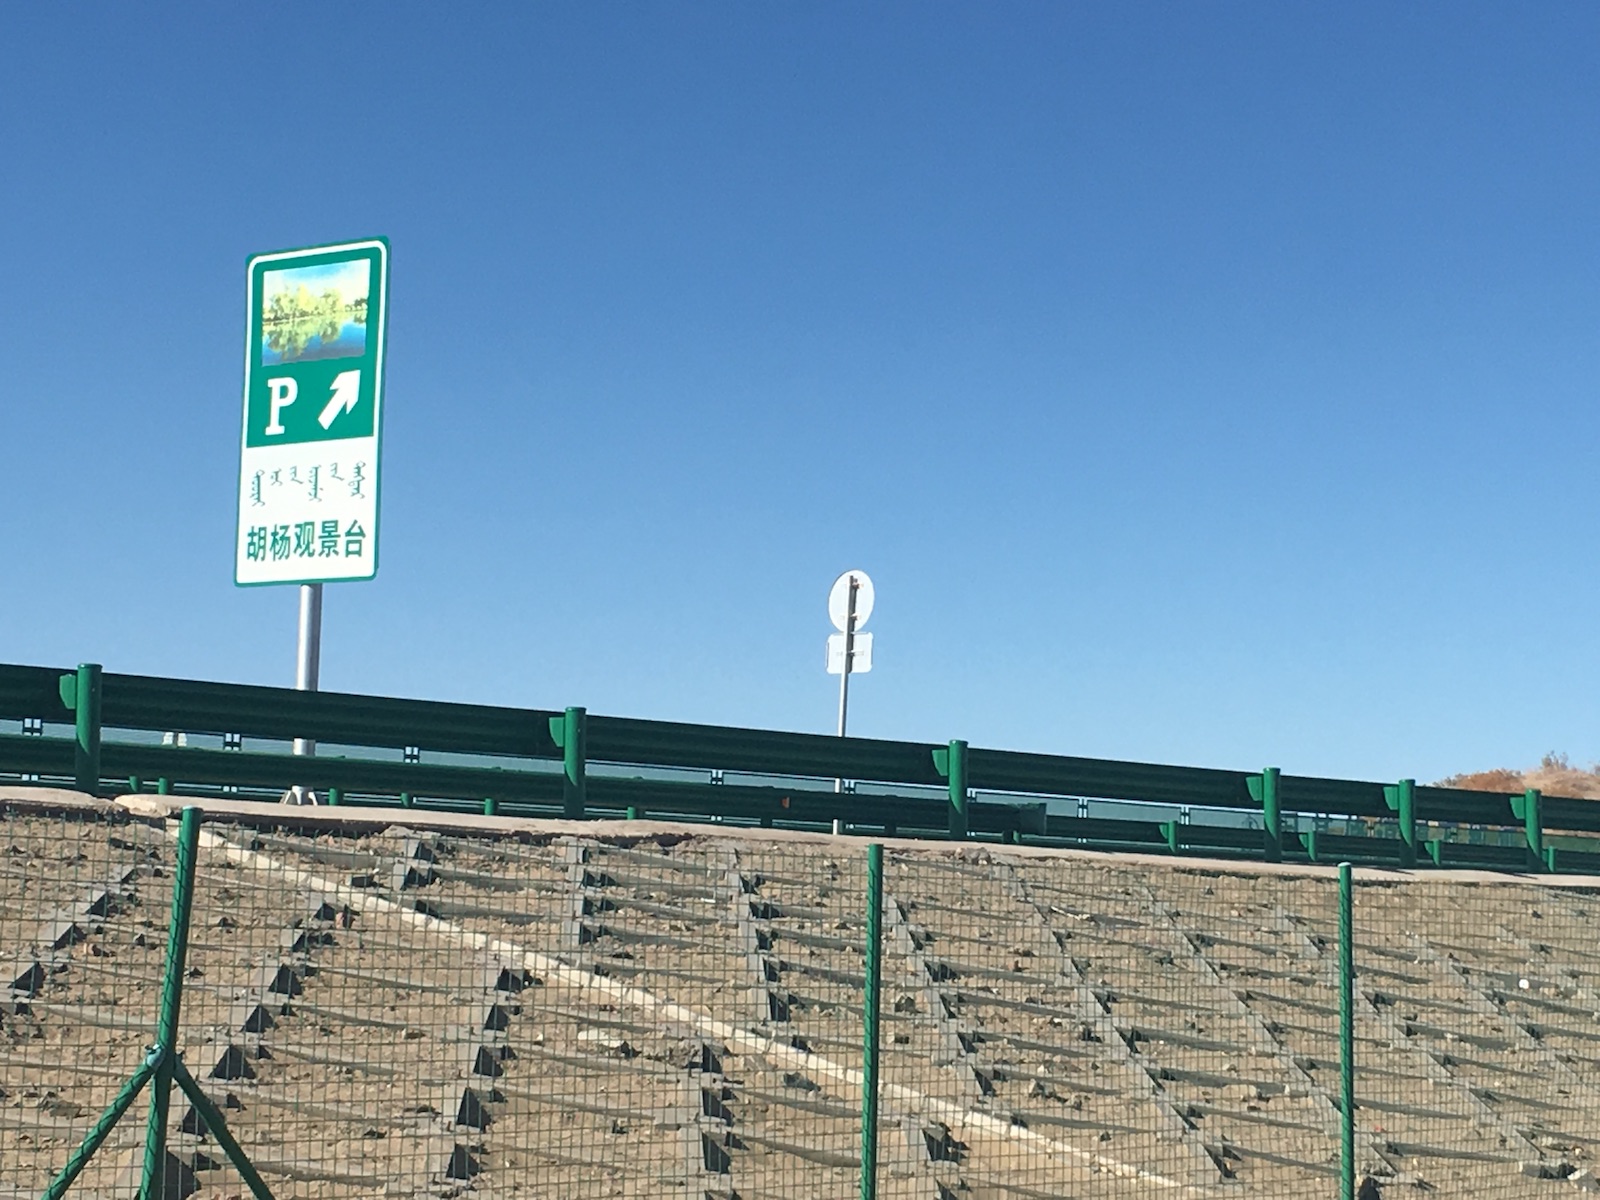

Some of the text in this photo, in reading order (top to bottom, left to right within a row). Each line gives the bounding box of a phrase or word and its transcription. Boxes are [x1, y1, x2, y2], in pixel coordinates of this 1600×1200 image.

[264, 376, 298, 436] P
[246, 519, 366, 562] 胡杨观景台
